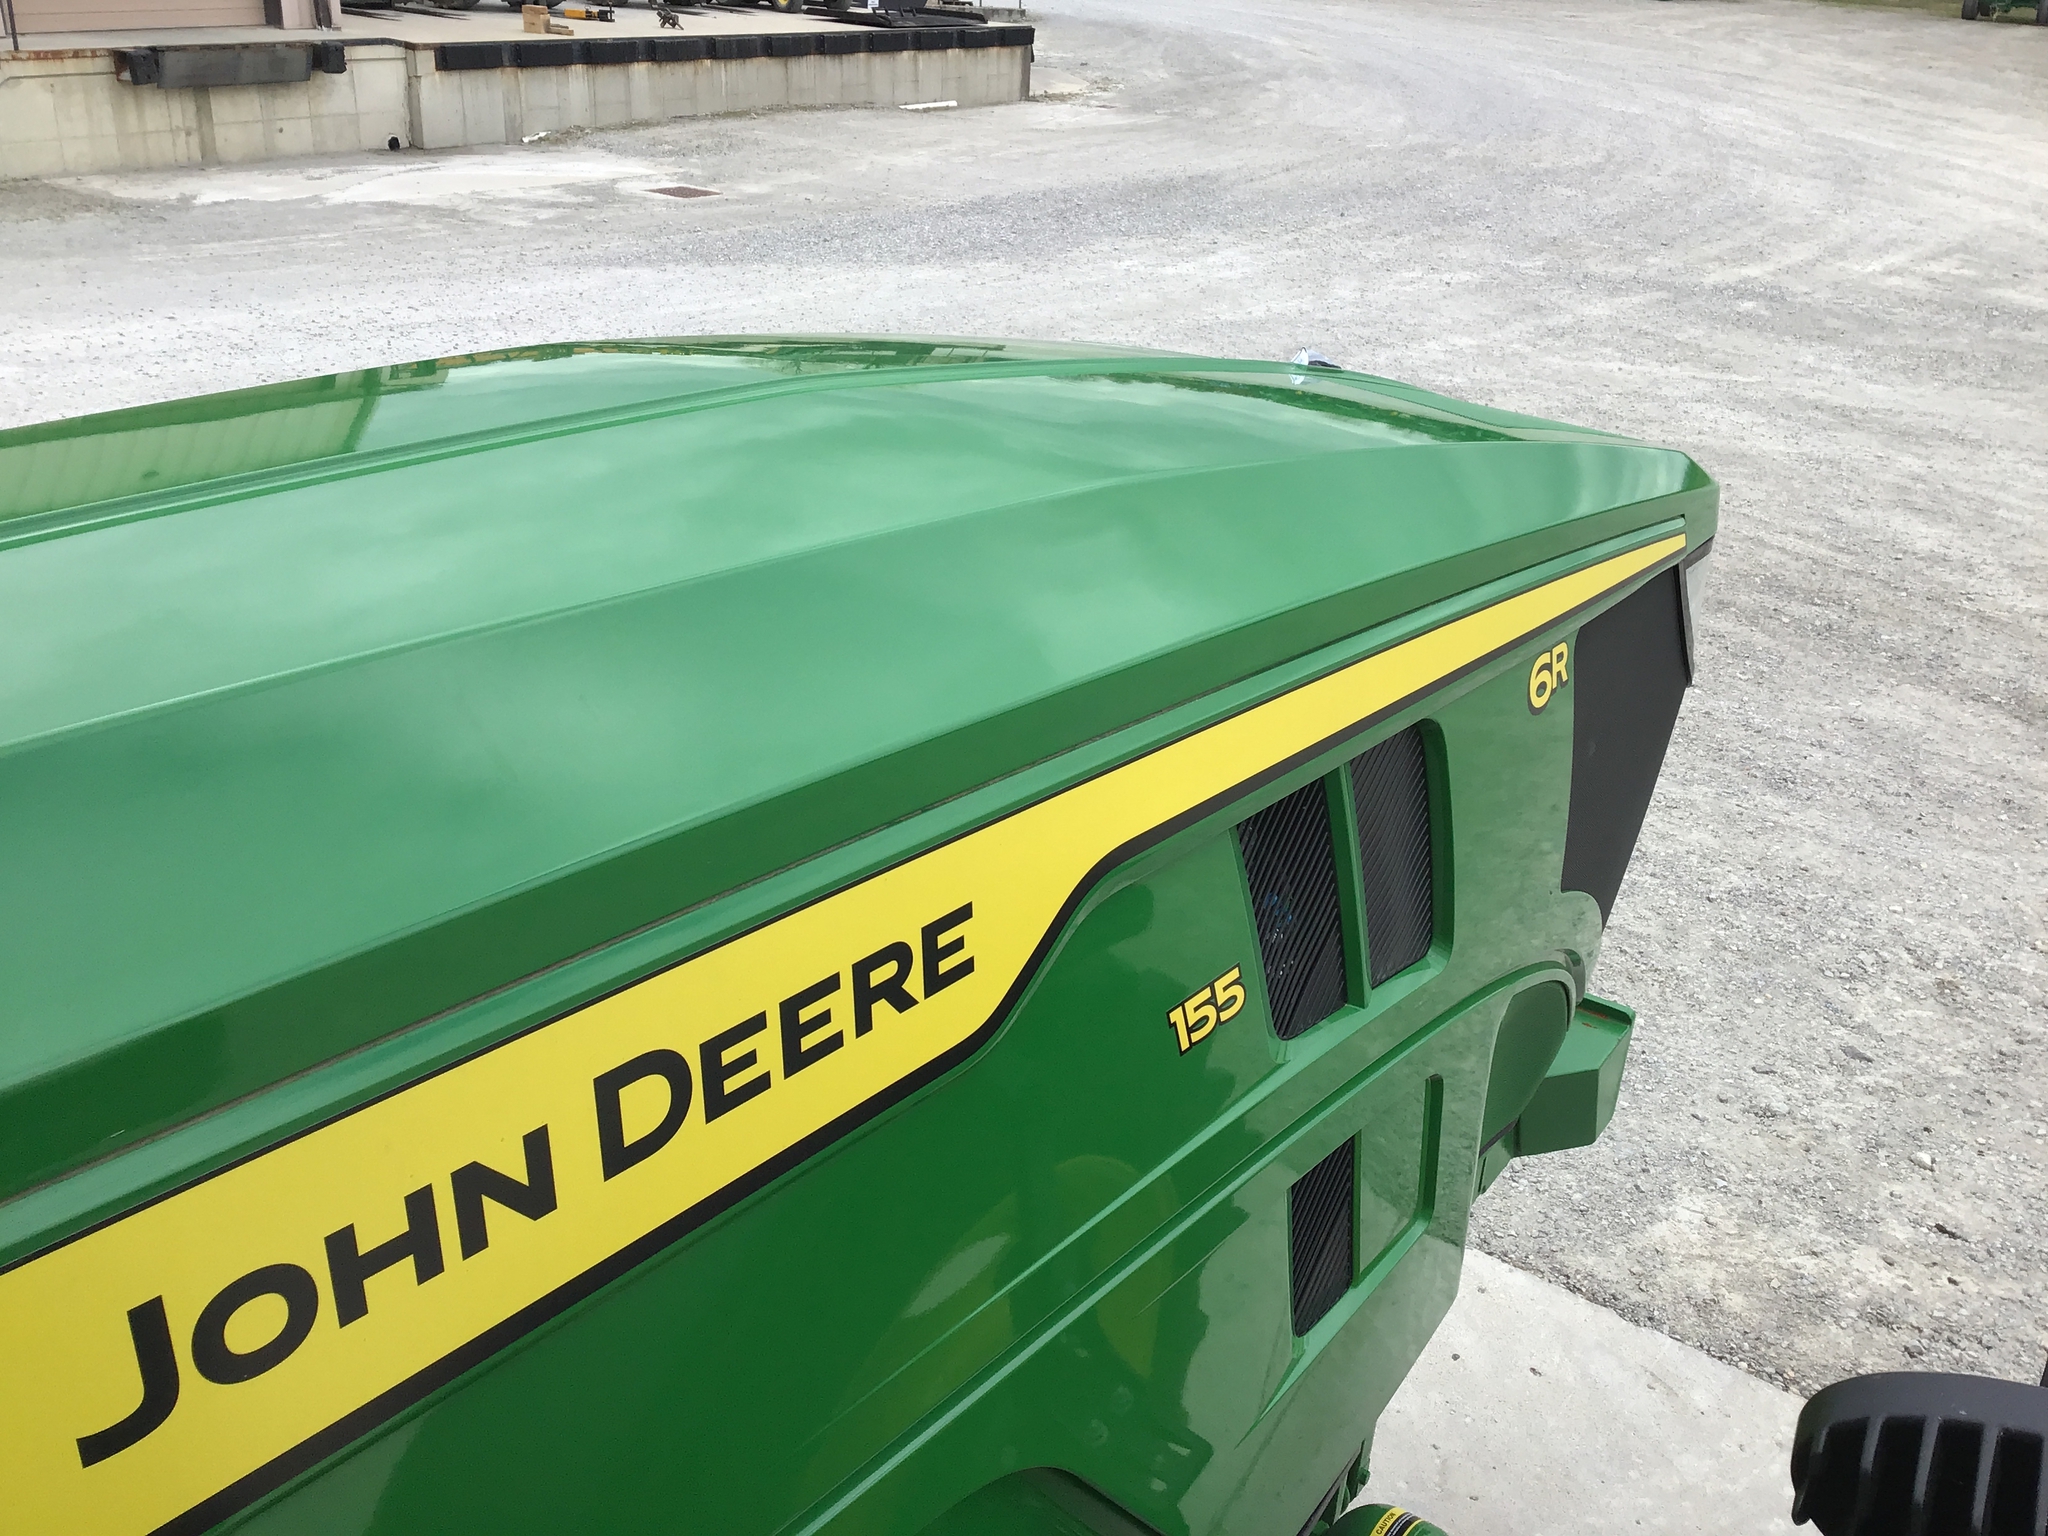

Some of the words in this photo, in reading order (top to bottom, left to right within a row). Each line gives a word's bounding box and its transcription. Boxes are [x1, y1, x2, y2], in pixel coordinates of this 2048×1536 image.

[1528, 641, 1569, 713] 6R
[1167, 965, 1246, 1055] 155
[76, 1124, 558, 1469] JOHN
[593, 901, 975, 1182] DEERE
[1375, 1511, 1397, 1535] CAUTION
